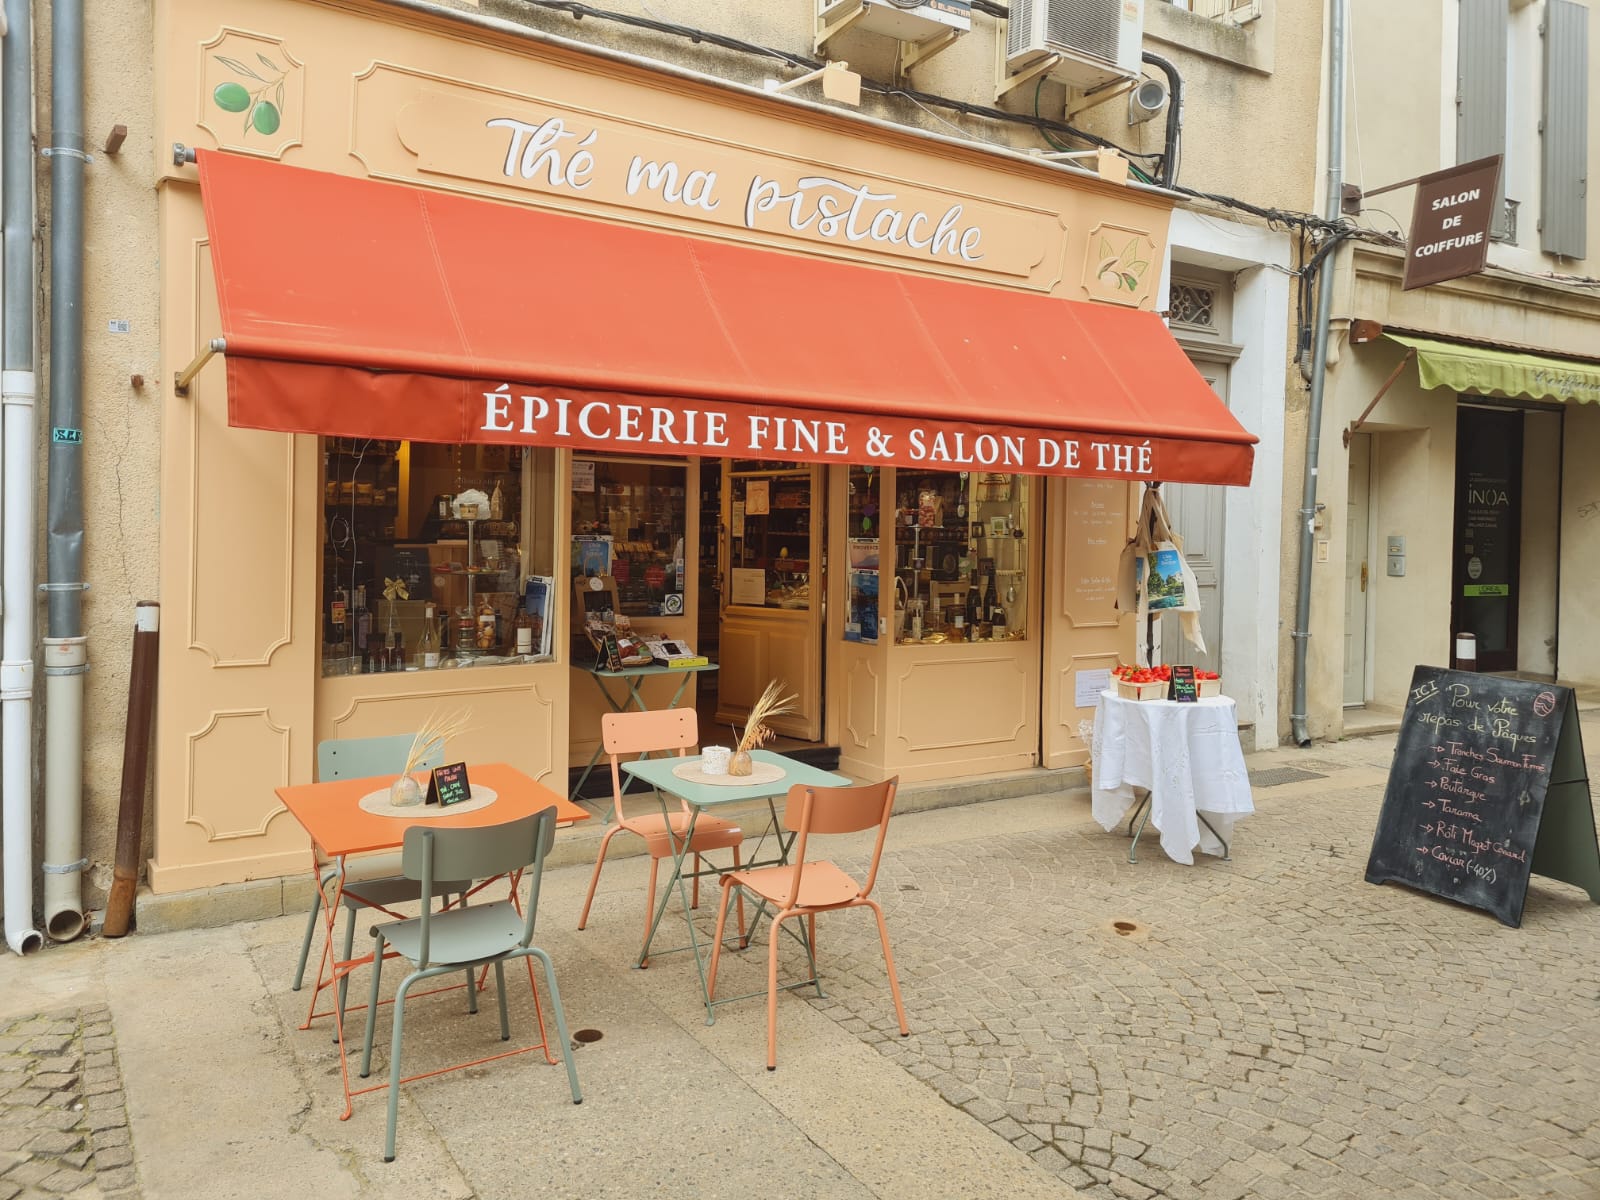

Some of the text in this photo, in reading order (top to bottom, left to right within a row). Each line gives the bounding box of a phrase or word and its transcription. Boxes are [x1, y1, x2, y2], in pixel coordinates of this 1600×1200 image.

[486, 117, 984, 262] Thé ma pistache
[1431, 188, 1480, 211] SALON
[1442, 214, 1462, 231] DE
[1415, 231, 1483, 258] COIFFURE
[480, 384, 1154, 475] ÉPICERIE FINE & SALON DE THÉ
[1412, 680, 1437, 700] ICI
[1449, 683, 1481, 710] Pour
[1418, 711, 1537, 752] repas de Pâques
[1446, 741, 1484, 761] Tranches
[1471, 766, 1496, 784] Gras
[1440, 777, 1487, 803] Poutargue
[1438, 798, 1483, 822] Tarama
